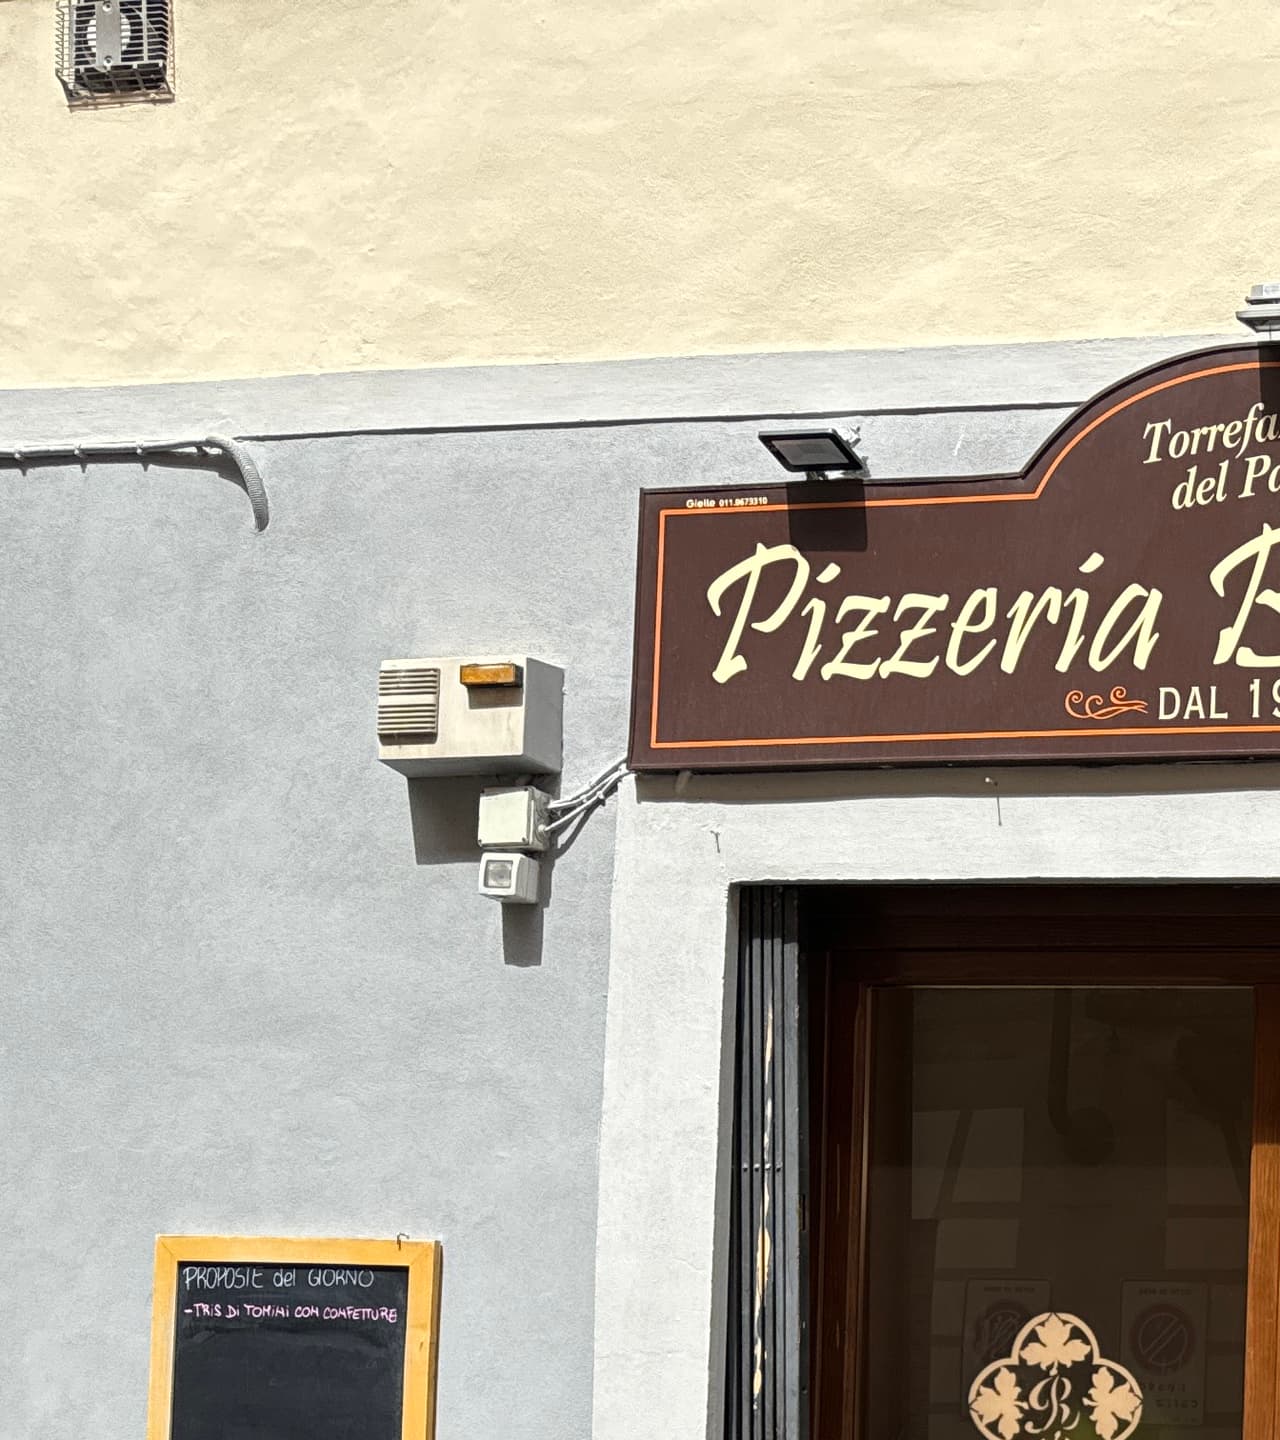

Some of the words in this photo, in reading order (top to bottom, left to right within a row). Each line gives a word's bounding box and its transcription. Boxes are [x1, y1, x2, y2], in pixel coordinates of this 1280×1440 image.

[1171, 459, 1229, 510] del
[706, 541, 1164, 684] Pizzeria
[1159, 685, 1229, 721] DAL
[273, 1268, 296, 1288] del
[308, 1268, 374, 1288] GIORNO
[295, 1305, 319, 1319] CON
[323, 1305, 398, 1323] CONFETTURE
